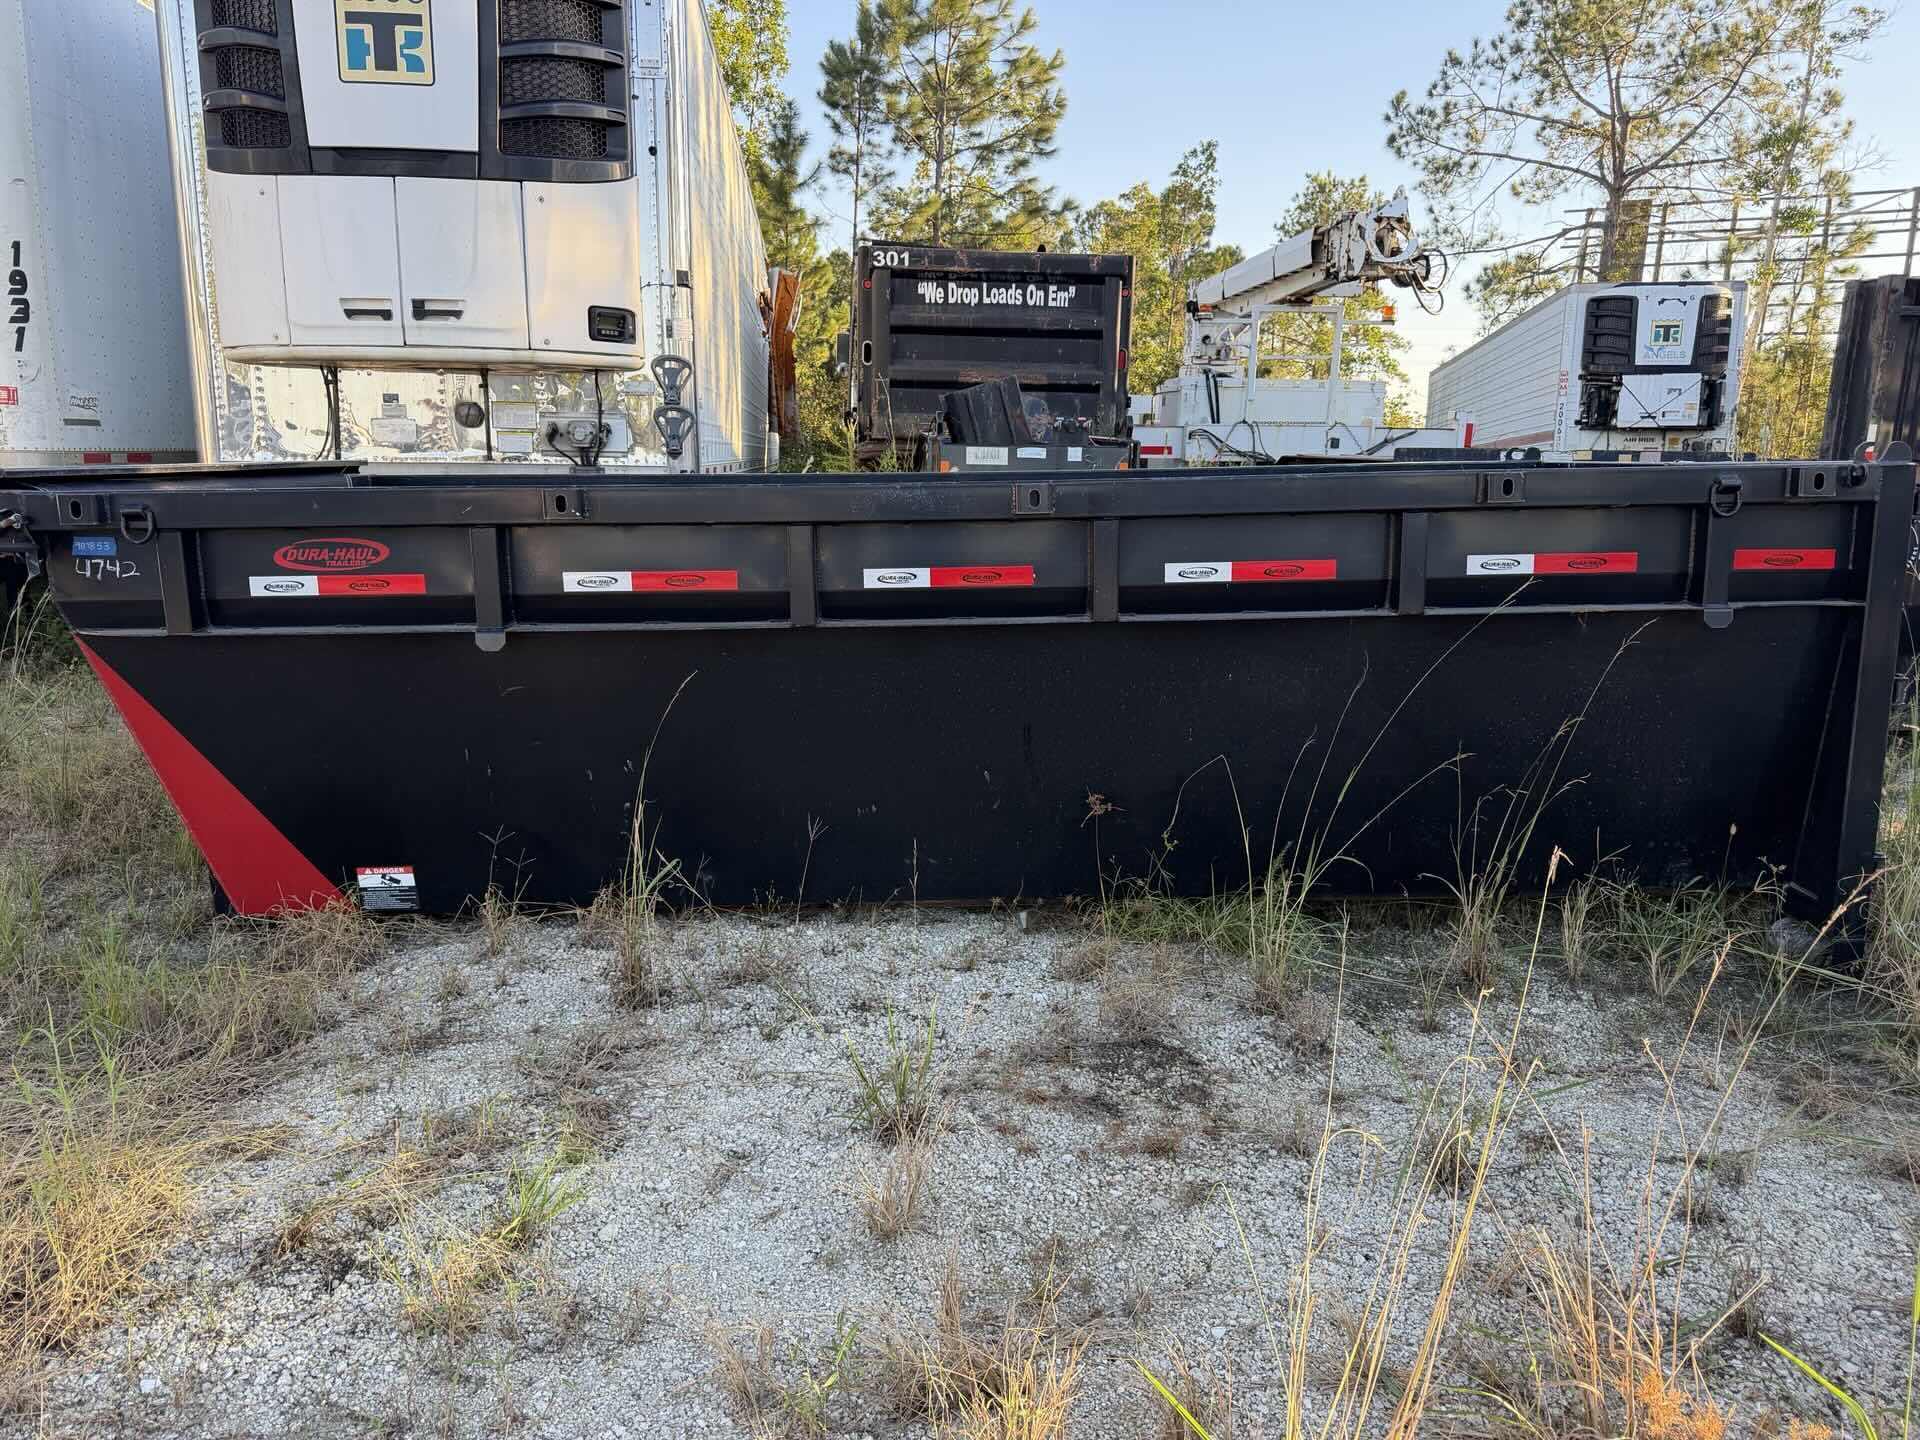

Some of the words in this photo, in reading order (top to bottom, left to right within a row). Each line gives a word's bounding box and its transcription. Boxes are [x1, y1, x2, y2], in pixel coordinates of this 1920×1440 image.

[872, 250, 910, 267] 301
[8, 240, 30, 352] 1931
[947, 282, 979, 307] Drop
[982, 282, 1023, 306] Loads
[1026, 283, 1045, 306] On
[286, 548, 378, 561] DURA-HAUL
[75, 557, 141, 581] 4742
